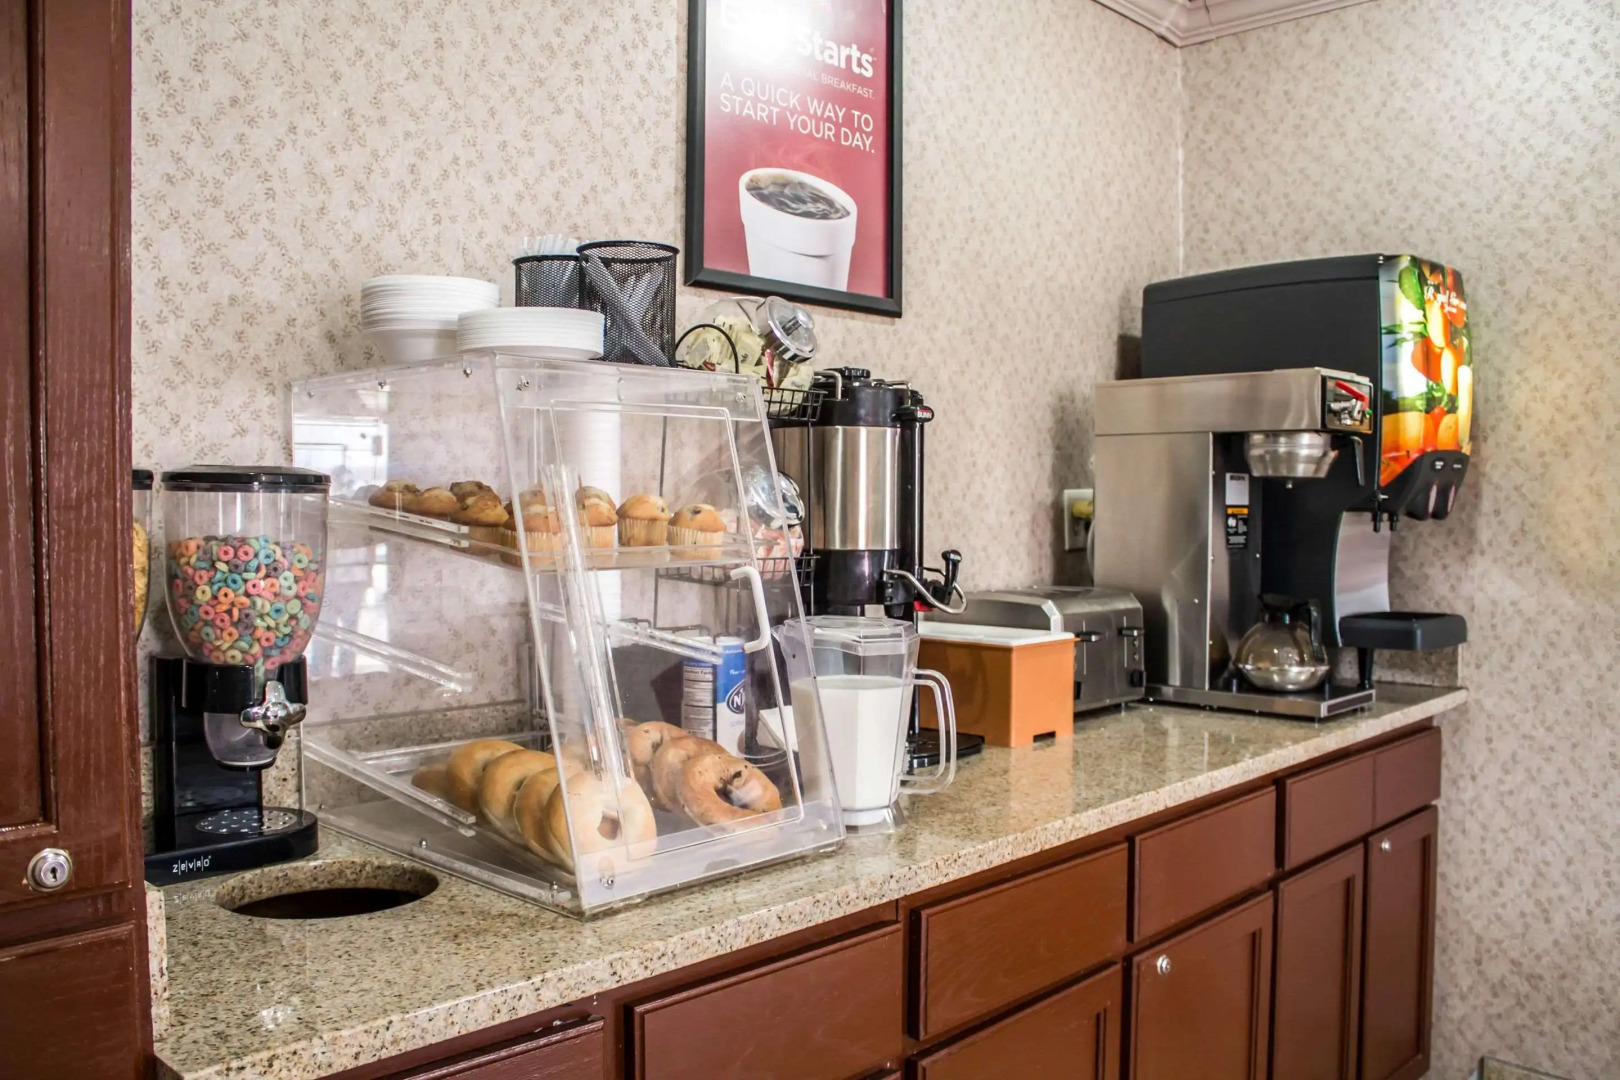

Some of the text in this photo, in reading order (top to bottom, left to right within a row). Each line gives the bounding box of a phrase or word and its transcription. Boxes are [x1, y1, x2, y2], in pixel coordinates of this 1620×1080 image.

[797, 27, 874, 78] Starts
[720, 72, 874, 132] A QUICK WAY TO
[821, 72, 875, 100] BREAKFAST.
[720, 93, 876, 154] START YOUR DAY.
